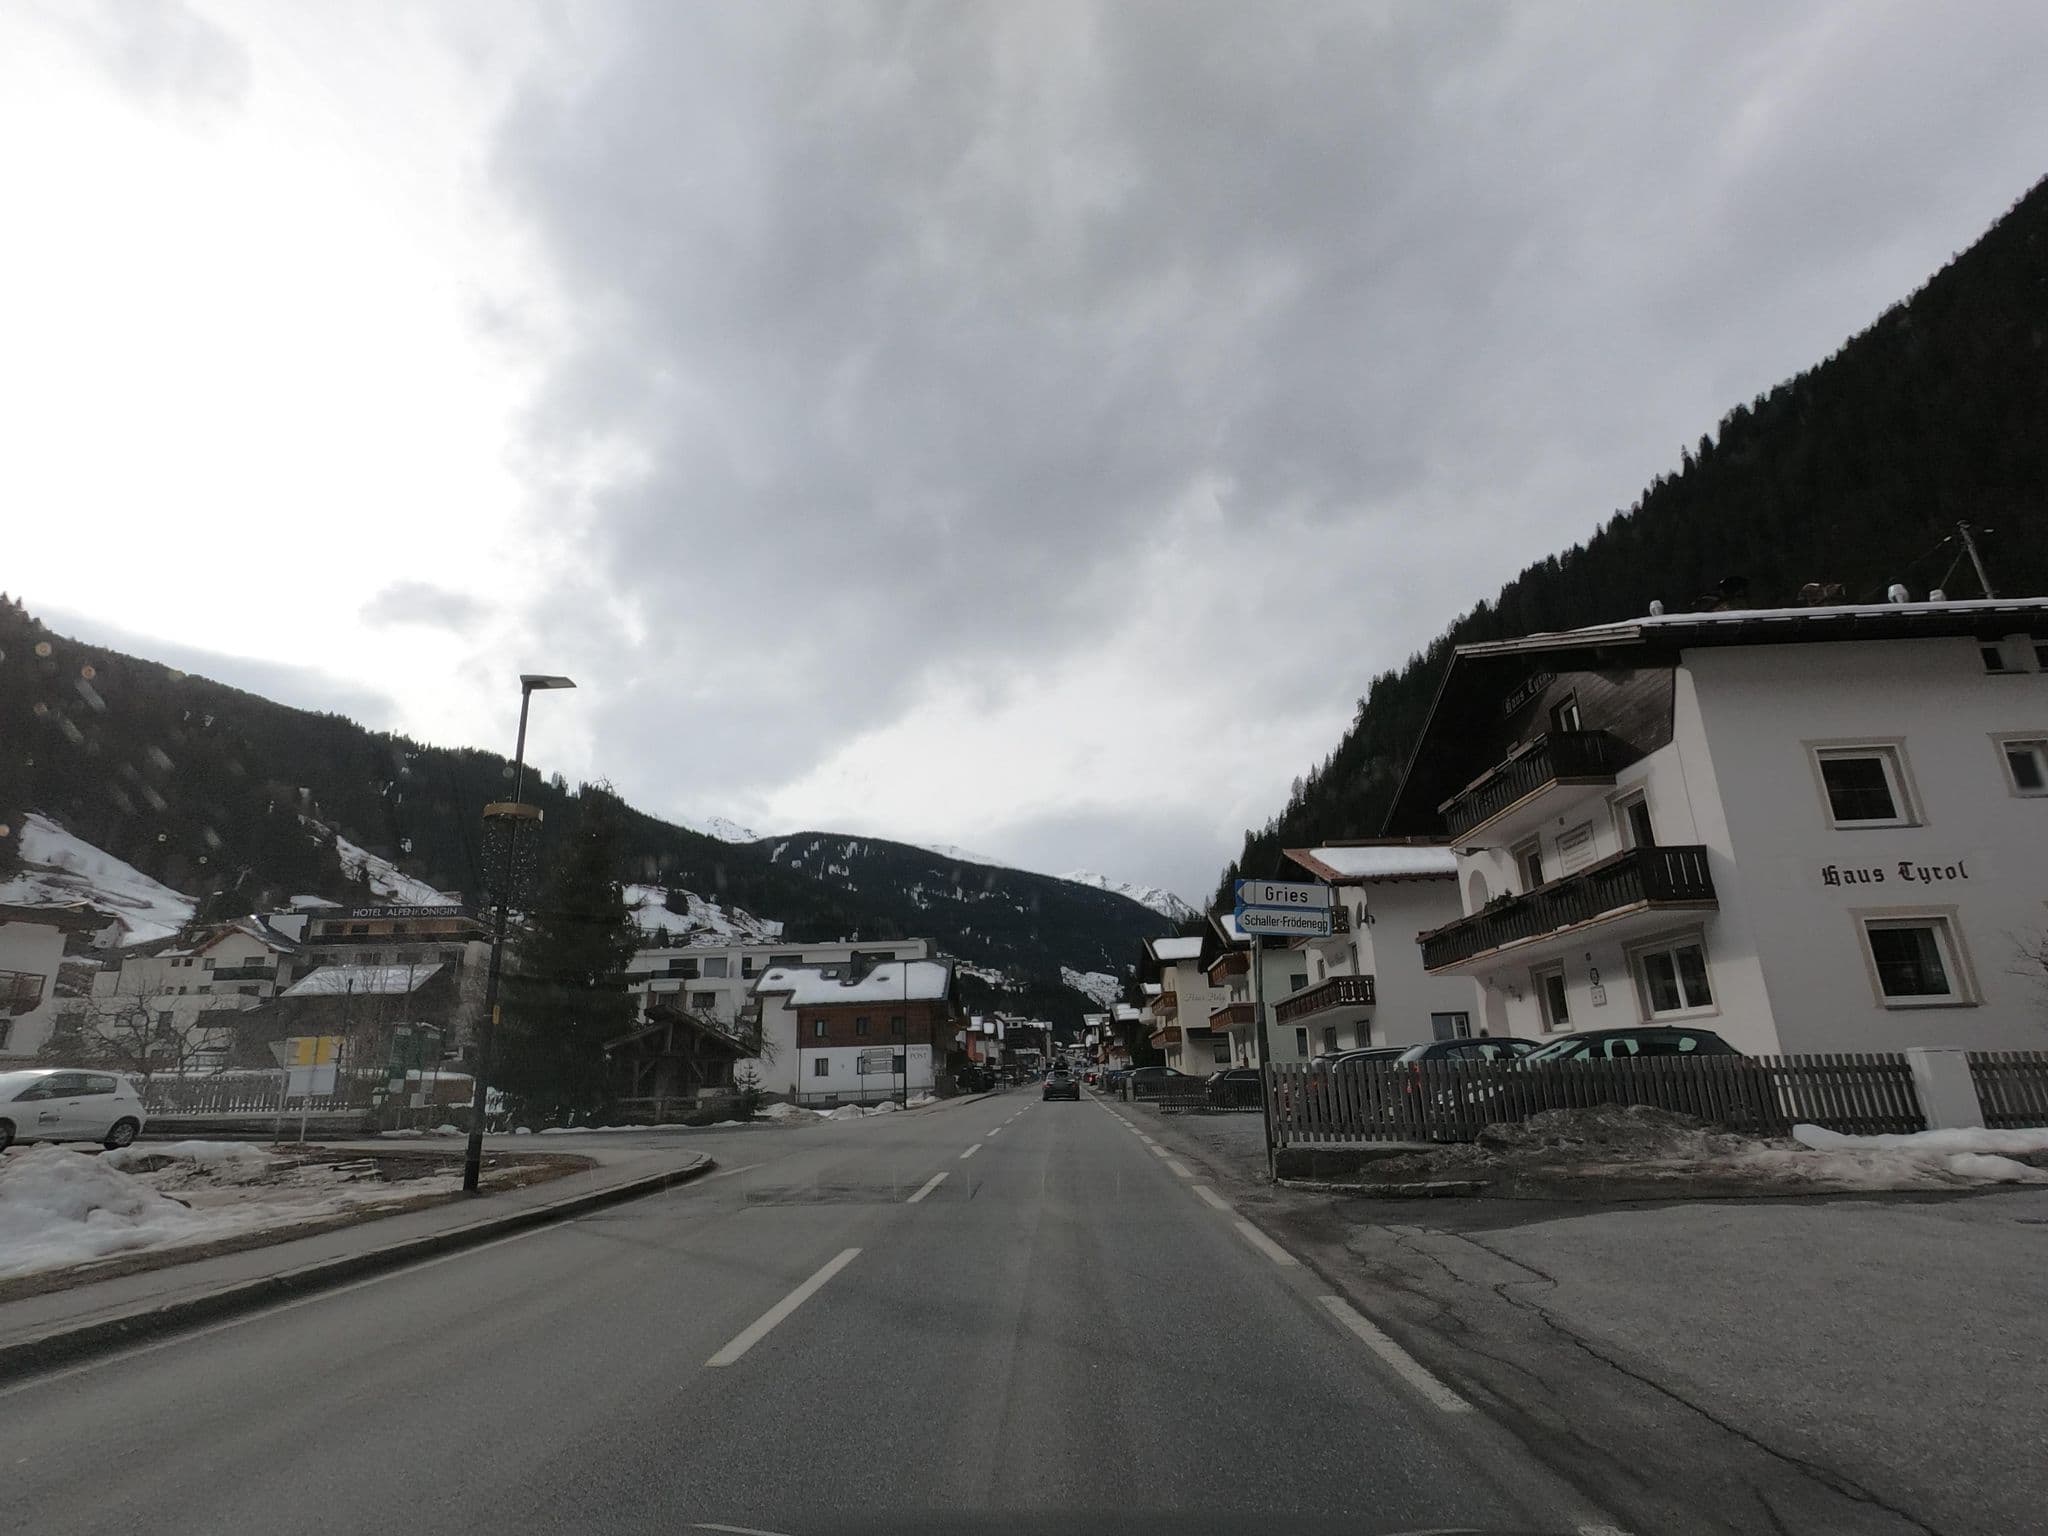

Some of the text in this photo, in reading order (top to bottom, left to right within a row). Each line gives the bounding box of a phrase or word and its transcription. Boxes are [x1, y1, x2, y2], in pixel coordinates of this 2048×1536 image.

[1822, 860, 1968, 886] Haus Tyrol
[1265, 886, 1308, 903] Gries
[352, 907, 381, 917] HOTEL
[1244, 914, 1328, 932] Schaller-Frödenegg
